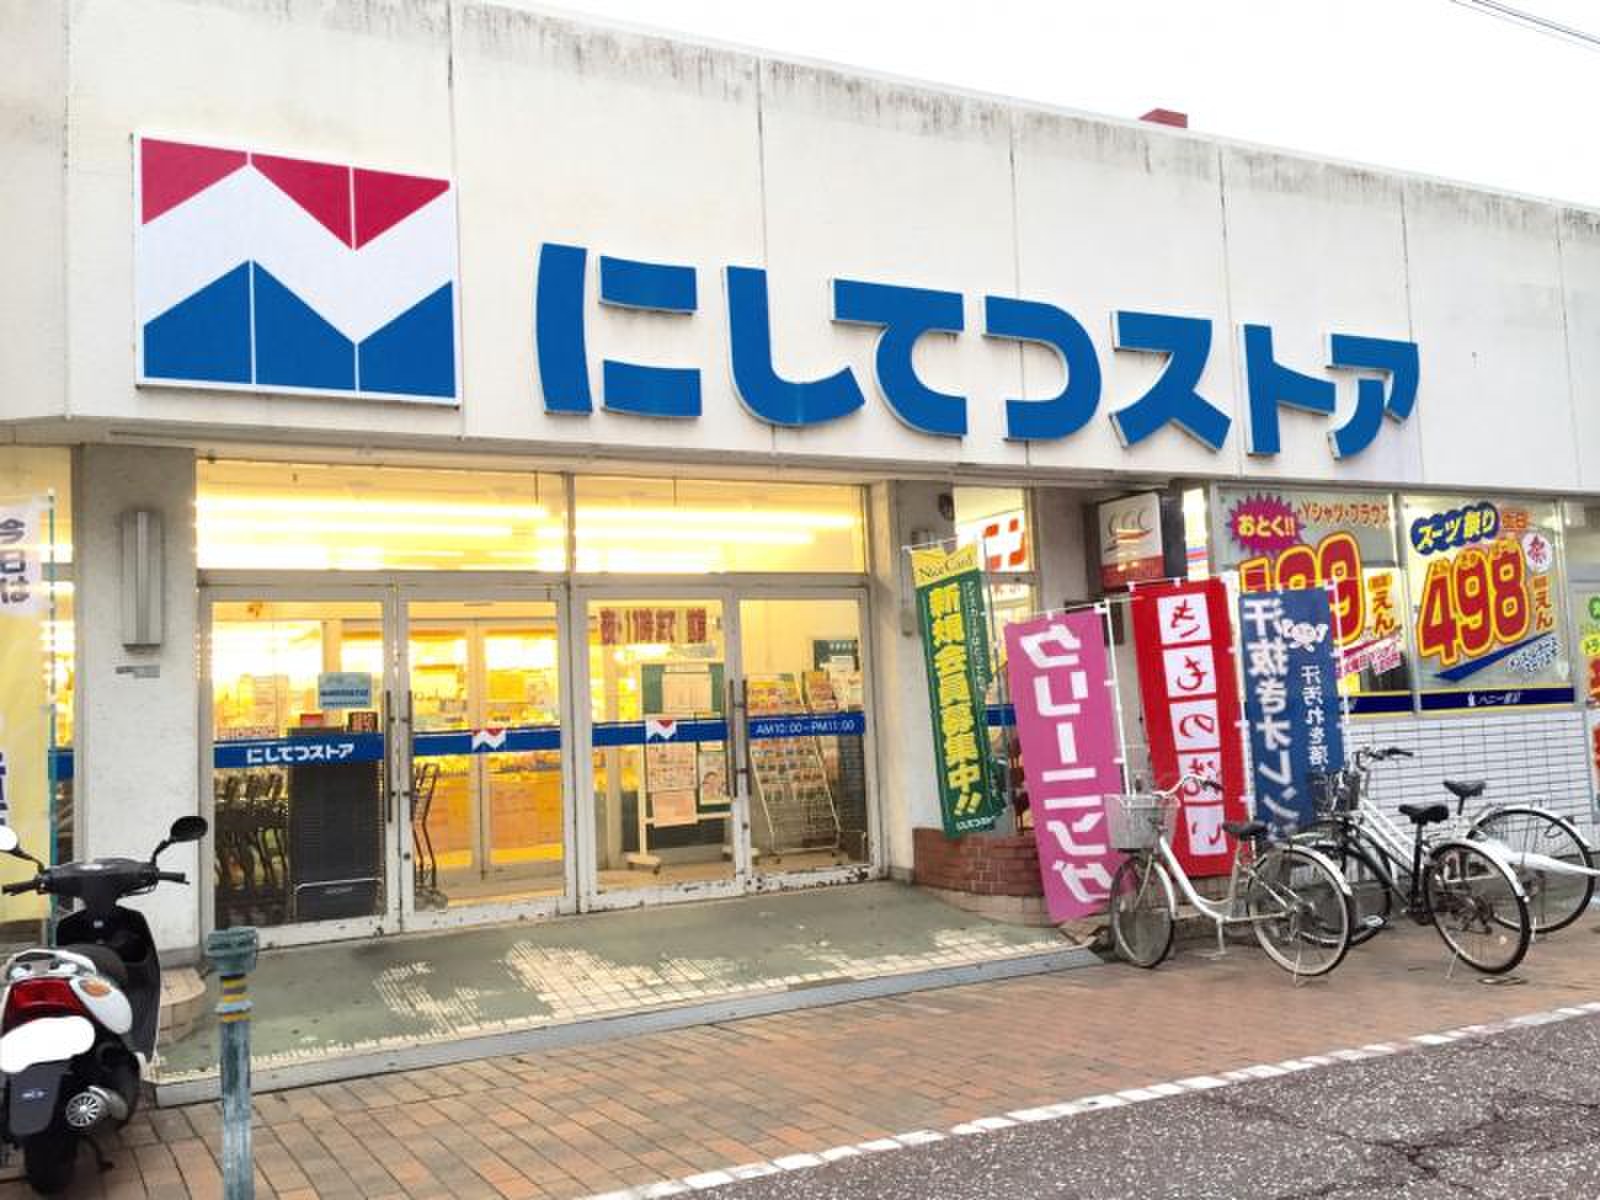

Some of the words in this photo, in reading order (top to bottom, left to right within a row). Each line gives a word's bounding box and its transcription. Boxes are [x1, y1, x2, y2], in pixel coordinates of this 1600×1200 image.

[535, 241, 1420, 460] にしてつストア
[1420, 546, 1531, 665] 498
[246, 743, 355, 764] にしてつストア
